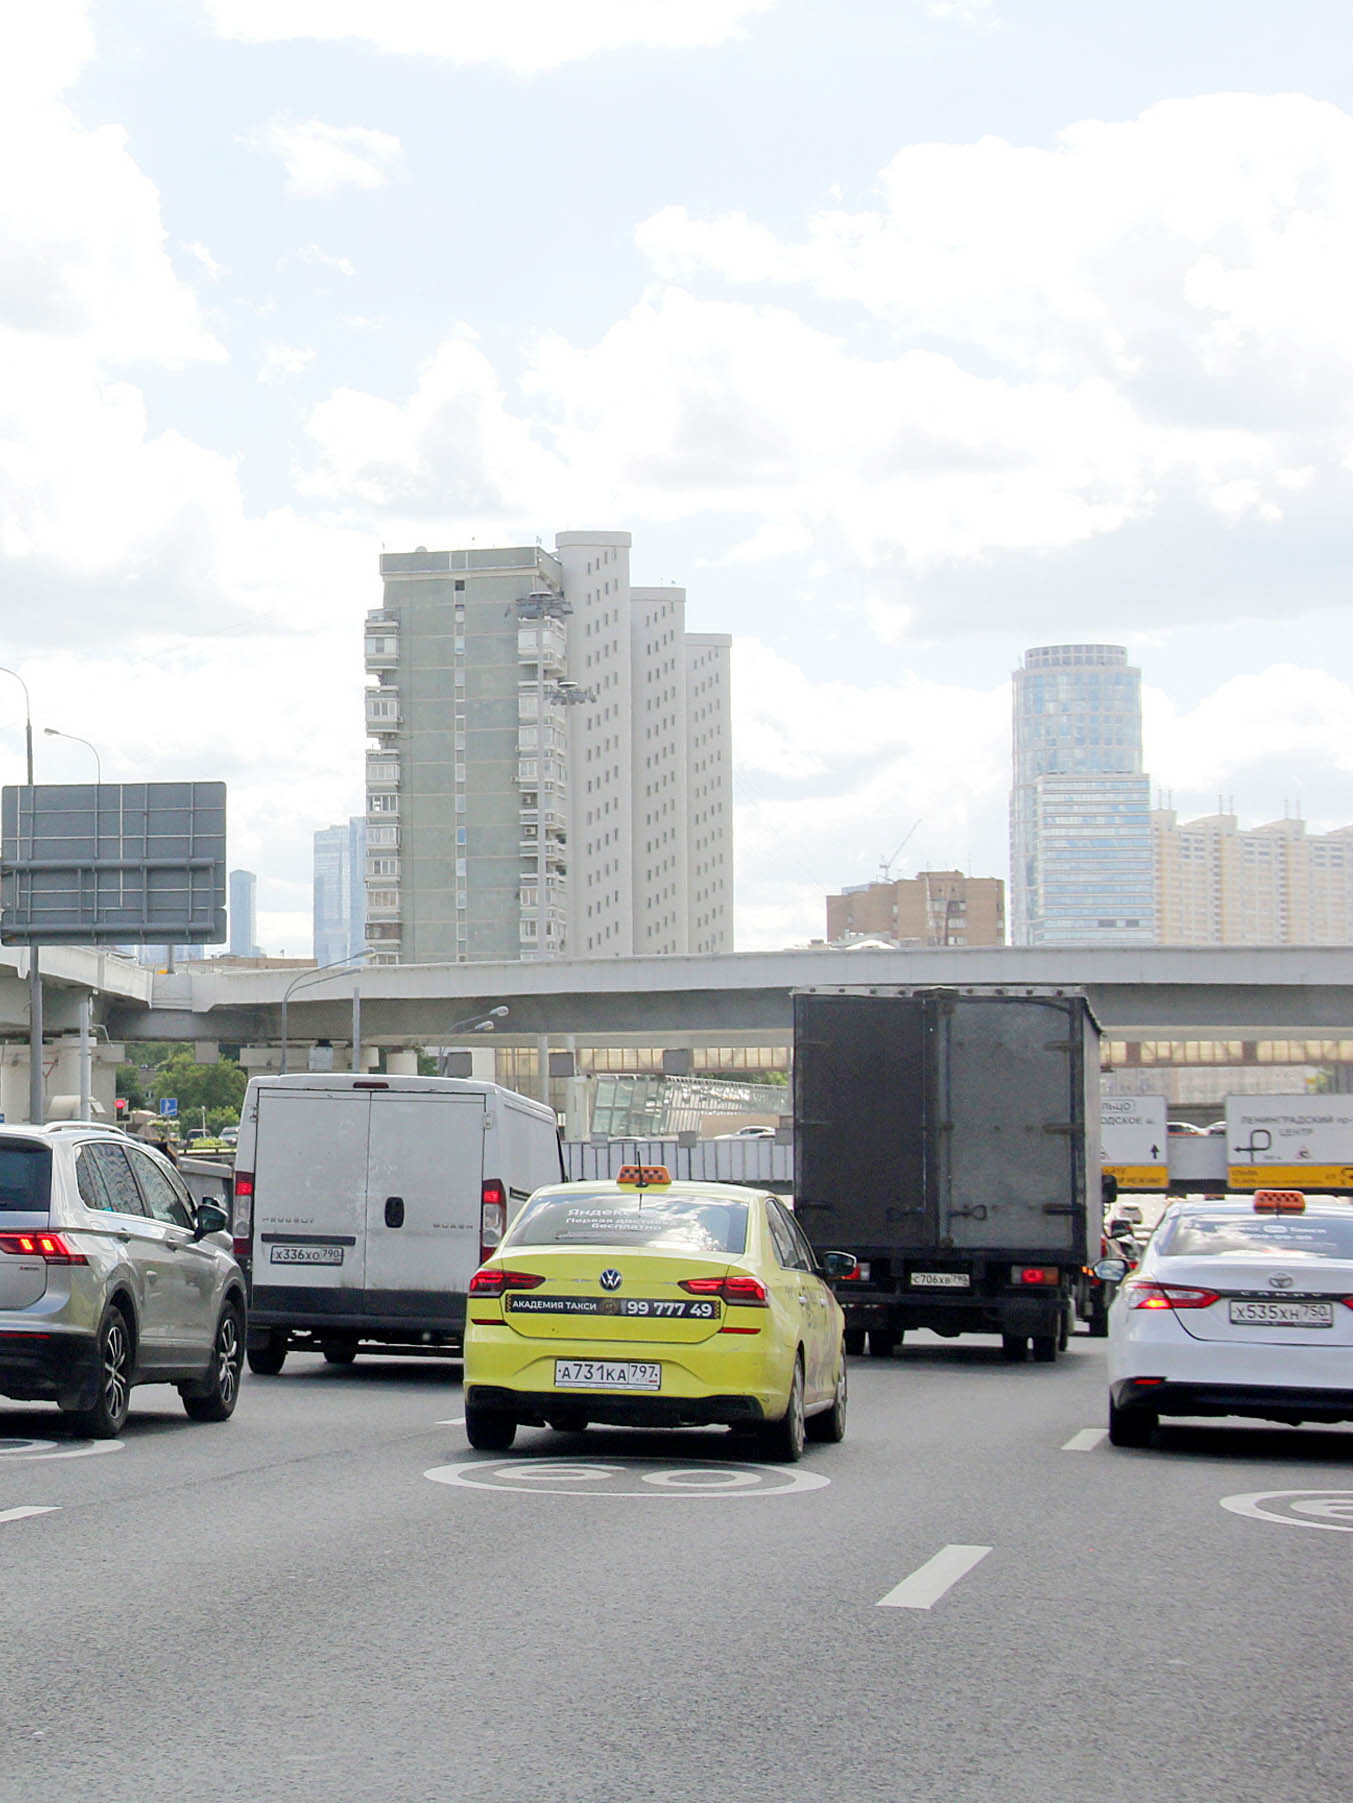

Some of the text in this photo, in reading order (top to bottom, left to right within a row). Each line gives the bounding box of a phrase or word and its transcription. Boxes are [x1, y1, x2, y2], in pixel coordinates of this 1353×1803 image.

[512, 1299, 564, 1310] АКАДЕМИЯ
[565, 1301, 597, 1311] ТАКСИ
[627, 1301, 649, 1315] 99
[653, 1302, 686, 1316] 777
[690, 1303, 713, 1317] 49
[561, 1363, 656, 1382] А731КА 797
[492, 1463, 763, 1488] 60
